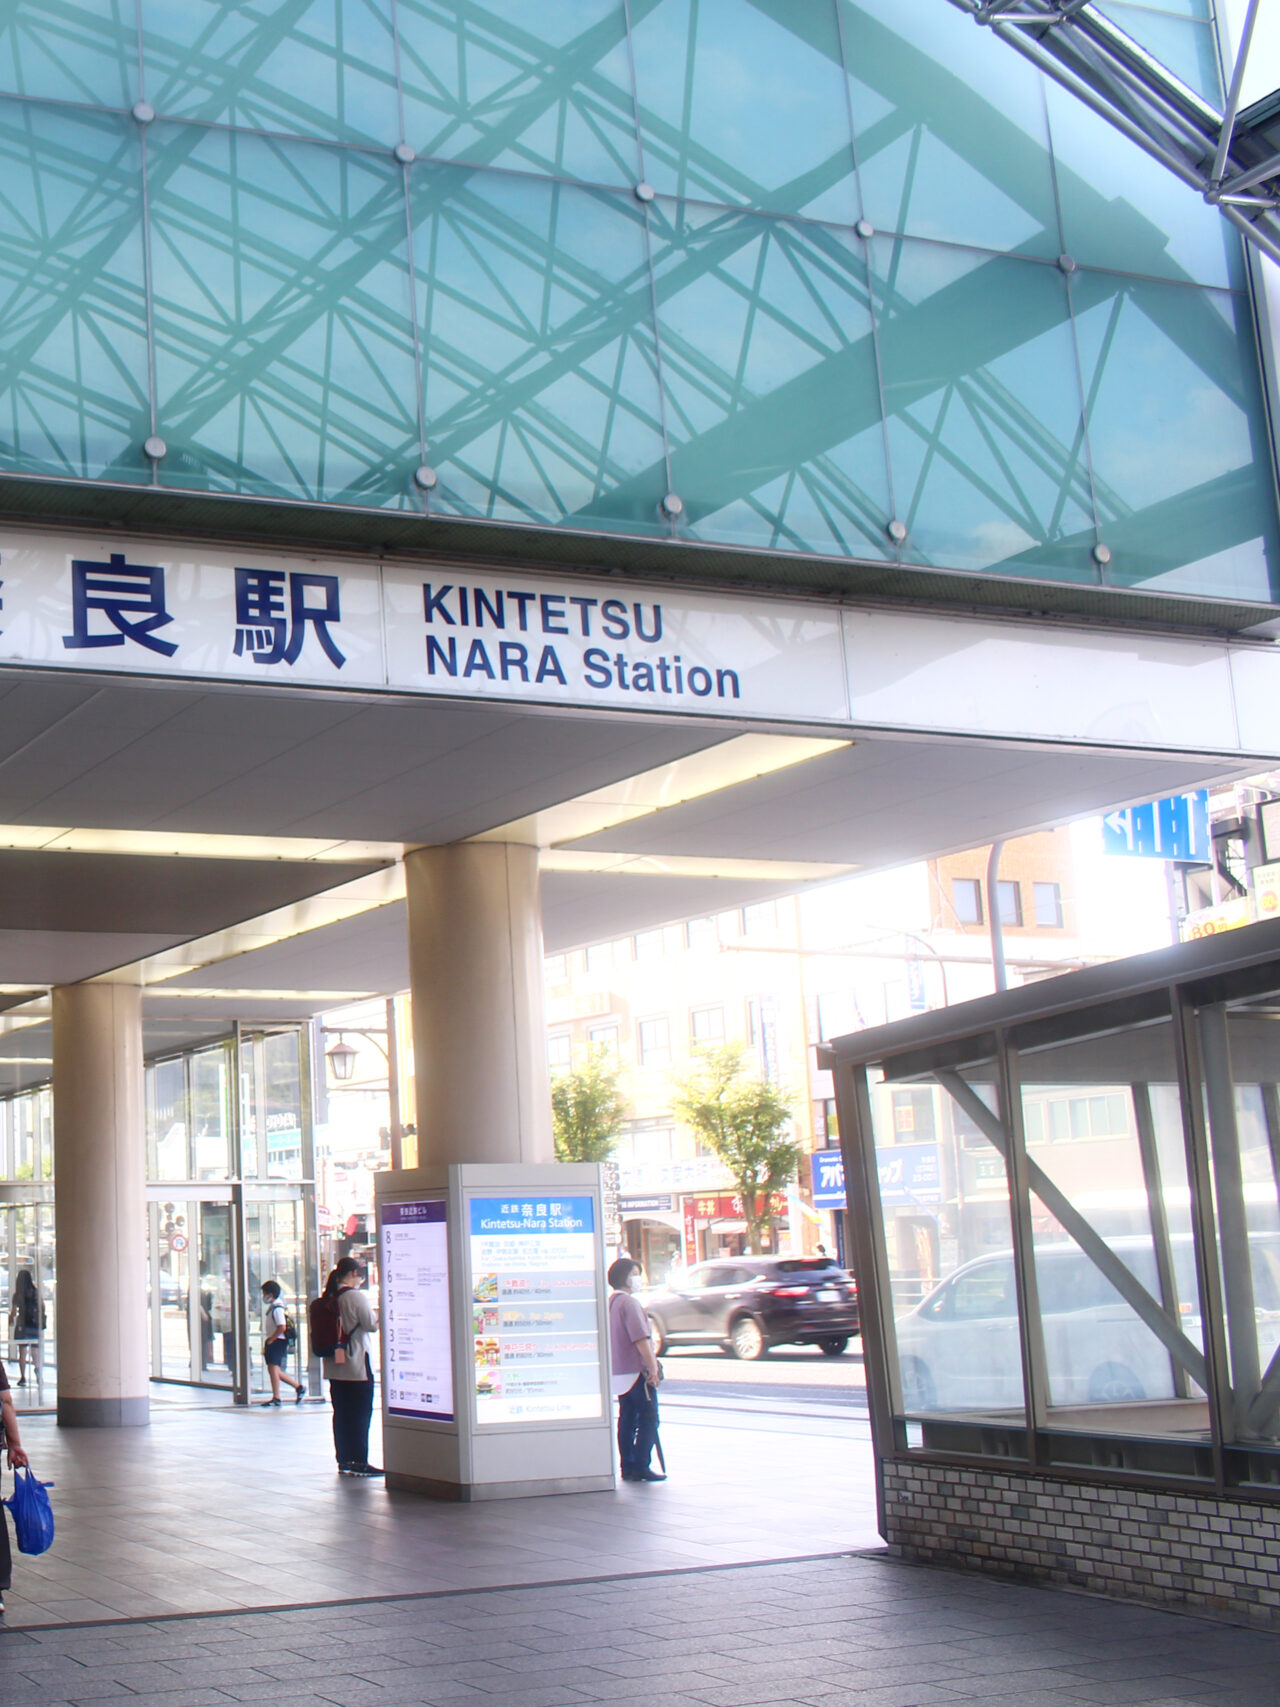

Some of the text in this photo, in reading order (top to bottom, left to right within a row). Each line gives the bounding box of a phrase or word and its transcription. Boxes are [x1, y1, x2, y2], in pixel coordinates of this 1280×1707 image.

[422, 582, 663, 643] KINTETSU
[425, 634, 741, 699] NARA Station
[481, 1216, 583, 1229] Kintetsu-Nara Station
[501, 1203, 562, 1217] 近鉄奈良駅
